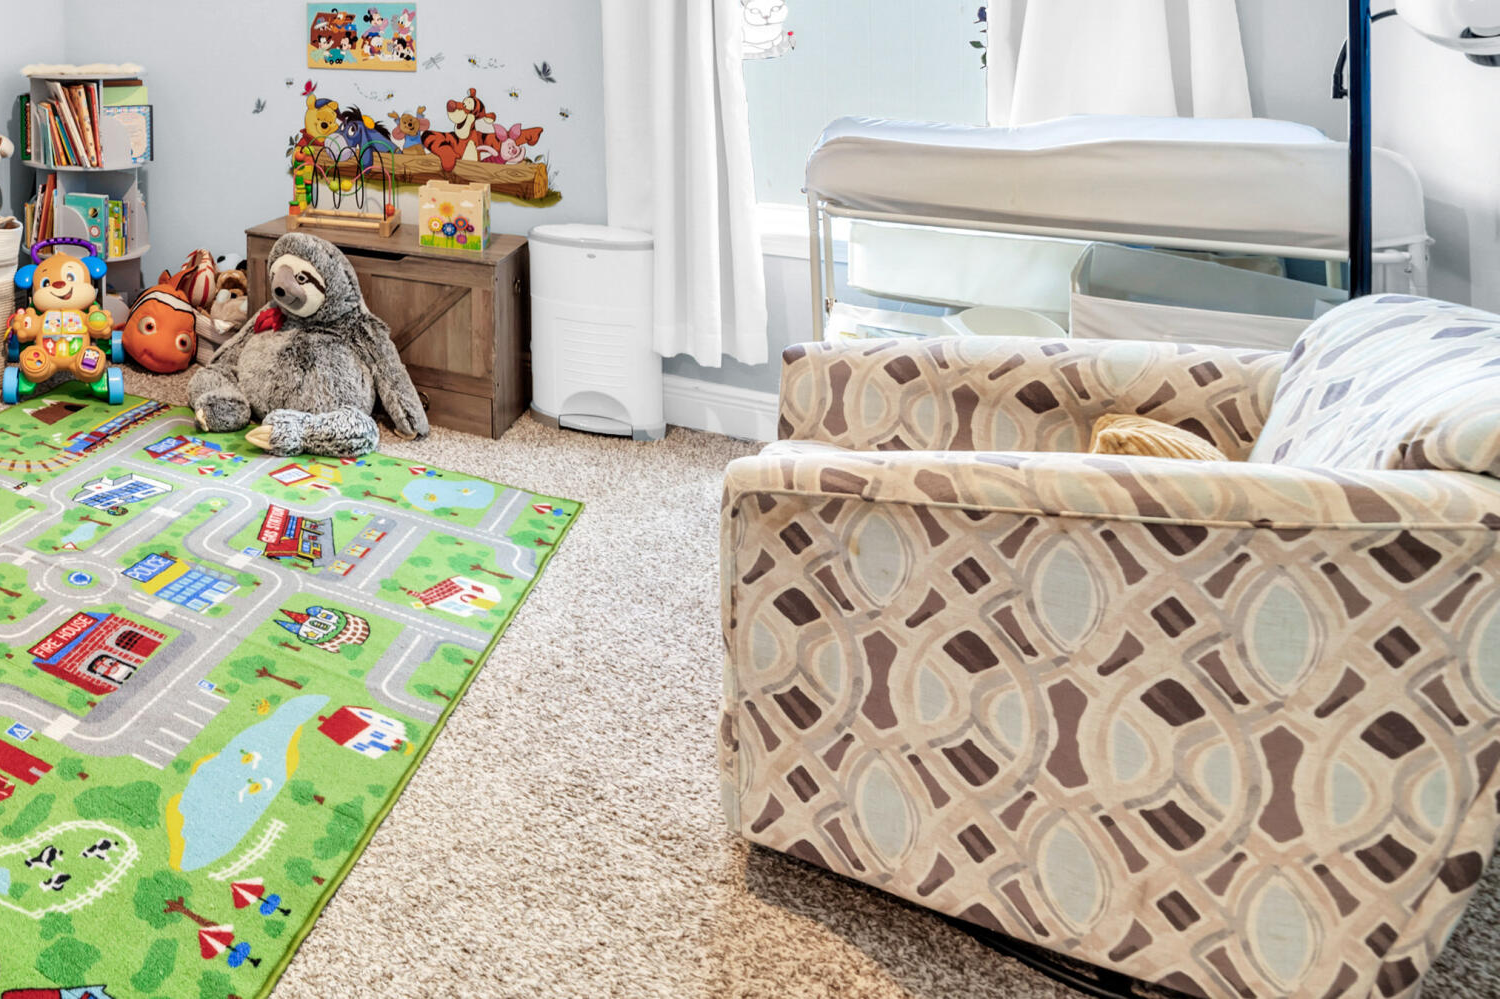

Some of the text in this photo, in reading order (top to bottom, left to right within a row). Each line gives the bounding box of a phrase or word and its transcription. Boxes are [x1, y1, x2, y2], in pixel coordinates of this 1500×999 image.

[261, 529, 279, 543] GAS
[127, 555, 172, 580] POLICE
[34, 615, 93, 657] FIRE HOUSE
